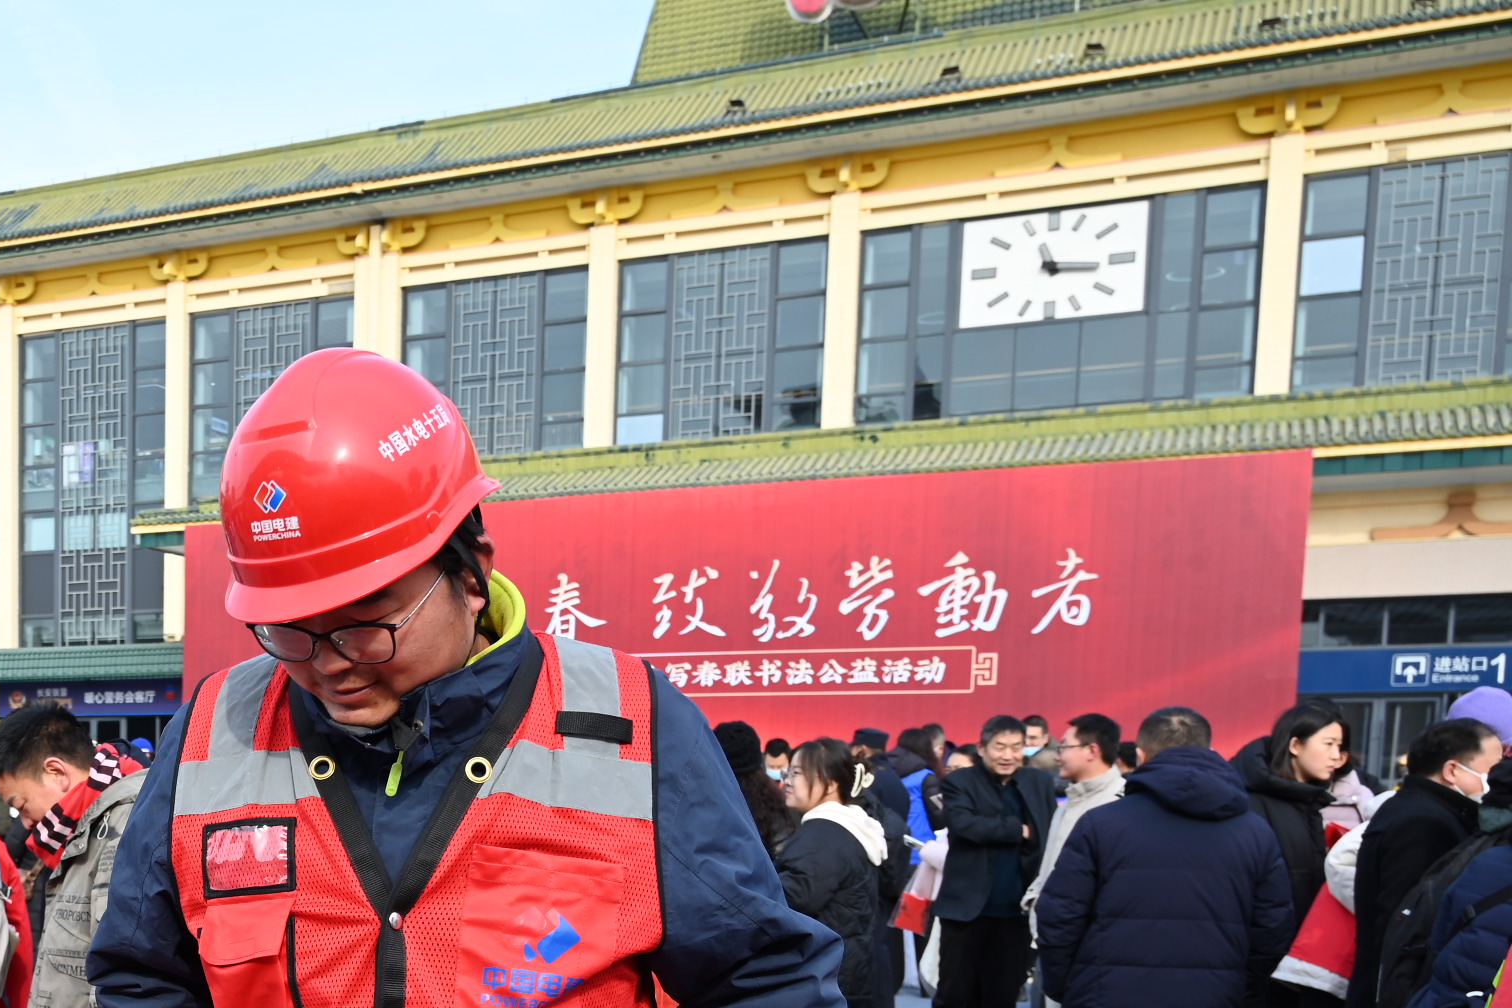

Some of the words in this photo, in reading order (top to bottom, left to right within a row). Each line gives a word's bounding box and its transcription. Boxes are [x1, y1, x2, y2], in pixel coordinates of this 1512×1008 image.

[251, 516, 300, 534] 中国电建
[253, 530, 301, 542] POWERCHINA
[665, 655, 946, 688] 写春联书法公益活动
[1433, 655, 1488, 673] 进站口
[1490, 652, 1506, 684] 1
[1431, 673, 1480, 683] Entrance
